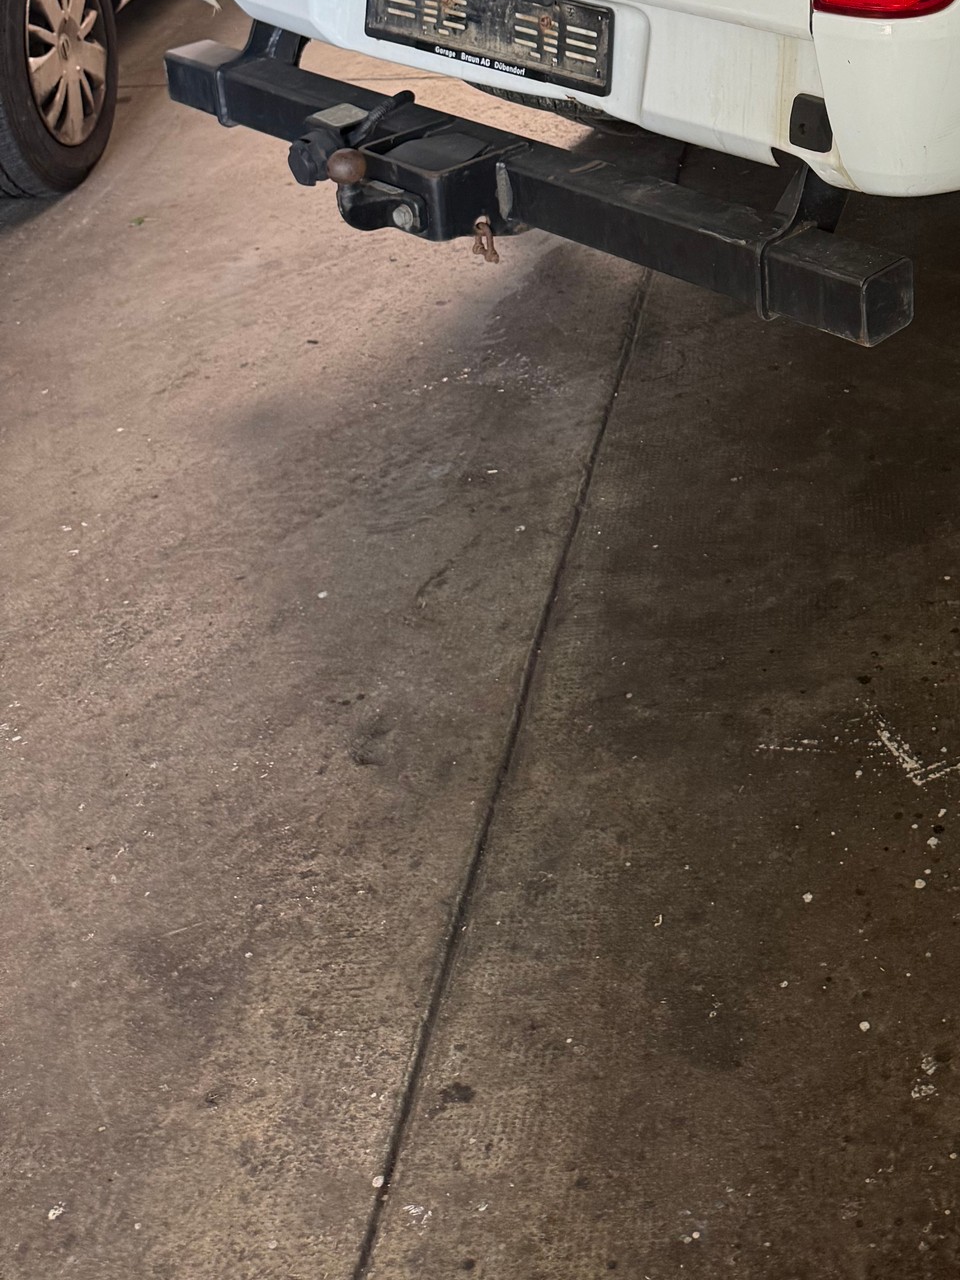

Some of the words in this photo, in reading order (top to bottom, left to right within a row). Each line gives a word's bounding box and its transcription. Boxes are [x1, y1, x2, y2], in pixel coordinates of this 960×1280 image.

[435, 45, 456, 58] Garage
[460, 52, 480, 65] Braun
[480, 58, 491, 67] AG
[494, 61, 526, 76] Dübendorf
